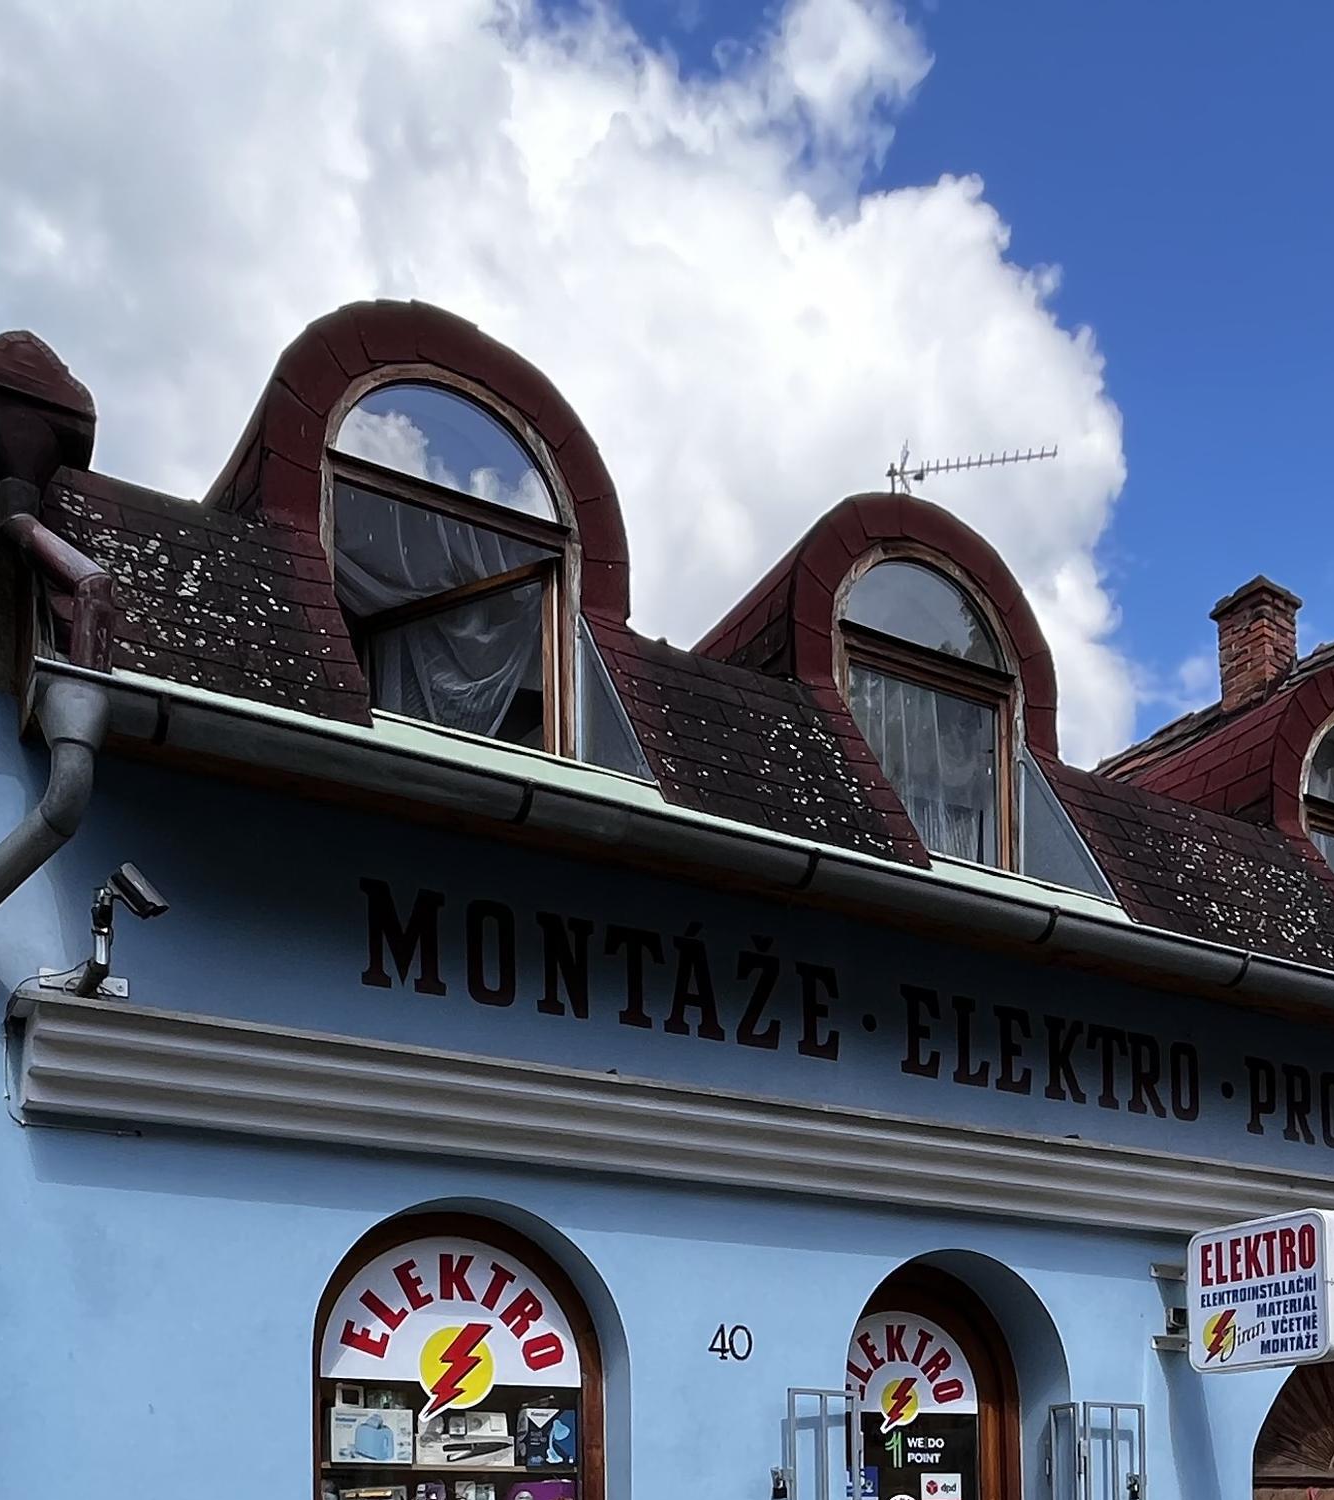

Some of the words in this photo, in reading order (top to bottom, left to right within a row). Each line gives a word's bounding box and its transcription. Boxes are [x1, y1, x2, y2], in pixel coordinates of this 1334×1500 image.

[359, 876, 841, 1062] MONTÁŽE
[898, 983, 1201, 1122] ELEKTRO
[1200, 1223, 1316, 1288] ELEKTRO
[1200, 1275, 1317, 1309] ELEKTROINSTALAČNÍ
[1256, 1295, 1318, 1319] MATERIÁL
[339, 1253, 565, 1371] ELEKTRO
[1271, 1314, 1318, 1335] VČETNĚ
[707, 1323, 753, 1361] 40
[1219, 1321, 1266, 1363] Jiran
[1260, 1332, 1318, 1356] MONTÁŽE
[907, 1452, 942, 1464] POINT
[940, 1482, 957, 1494] dpd
